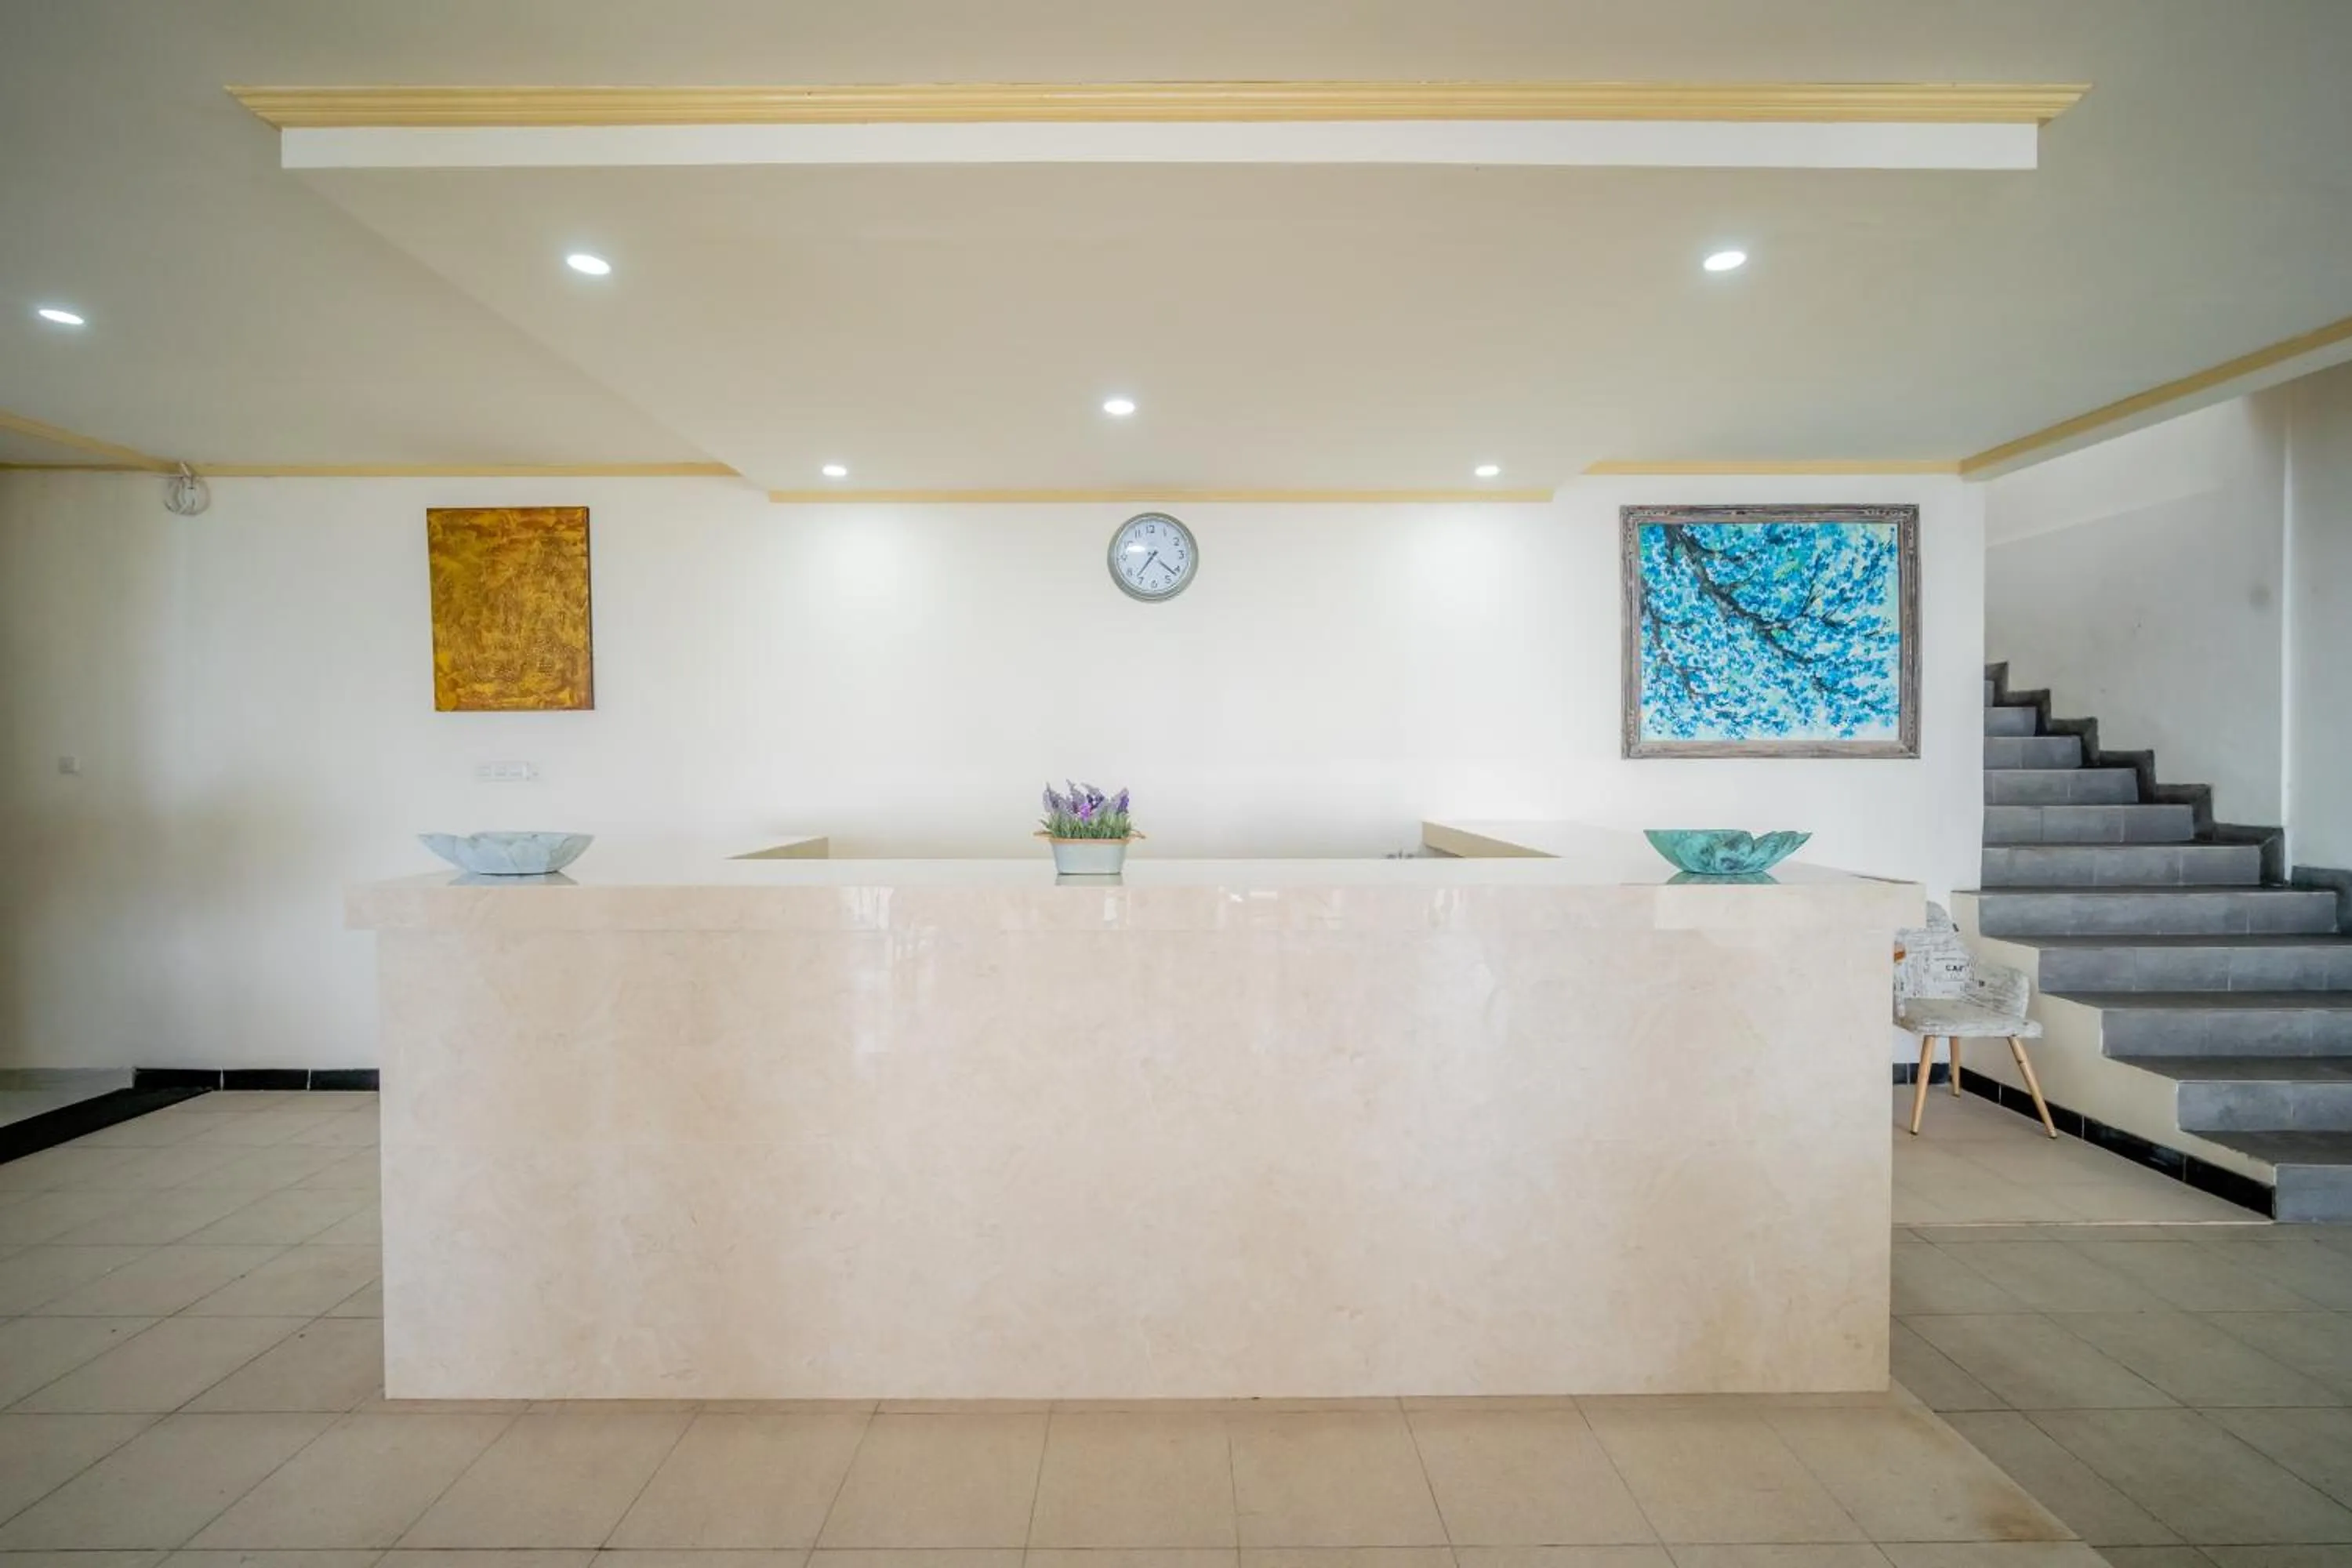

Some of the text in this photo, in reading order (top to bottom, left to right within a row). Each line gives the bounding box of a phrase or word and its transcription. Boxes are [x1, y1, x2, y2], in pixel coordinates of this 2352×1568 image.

[1134, 529, 1141, 539] 11
[1146, 524, 1155, 534] 12
[1173, 536, 1179, 546] 2
[1178, 550, 1185, 560] 3
[1138, 576, 1144, 585] 7
[1150, 579, 1158, 589] 6
[1164, 575, 1172, 584] 5
